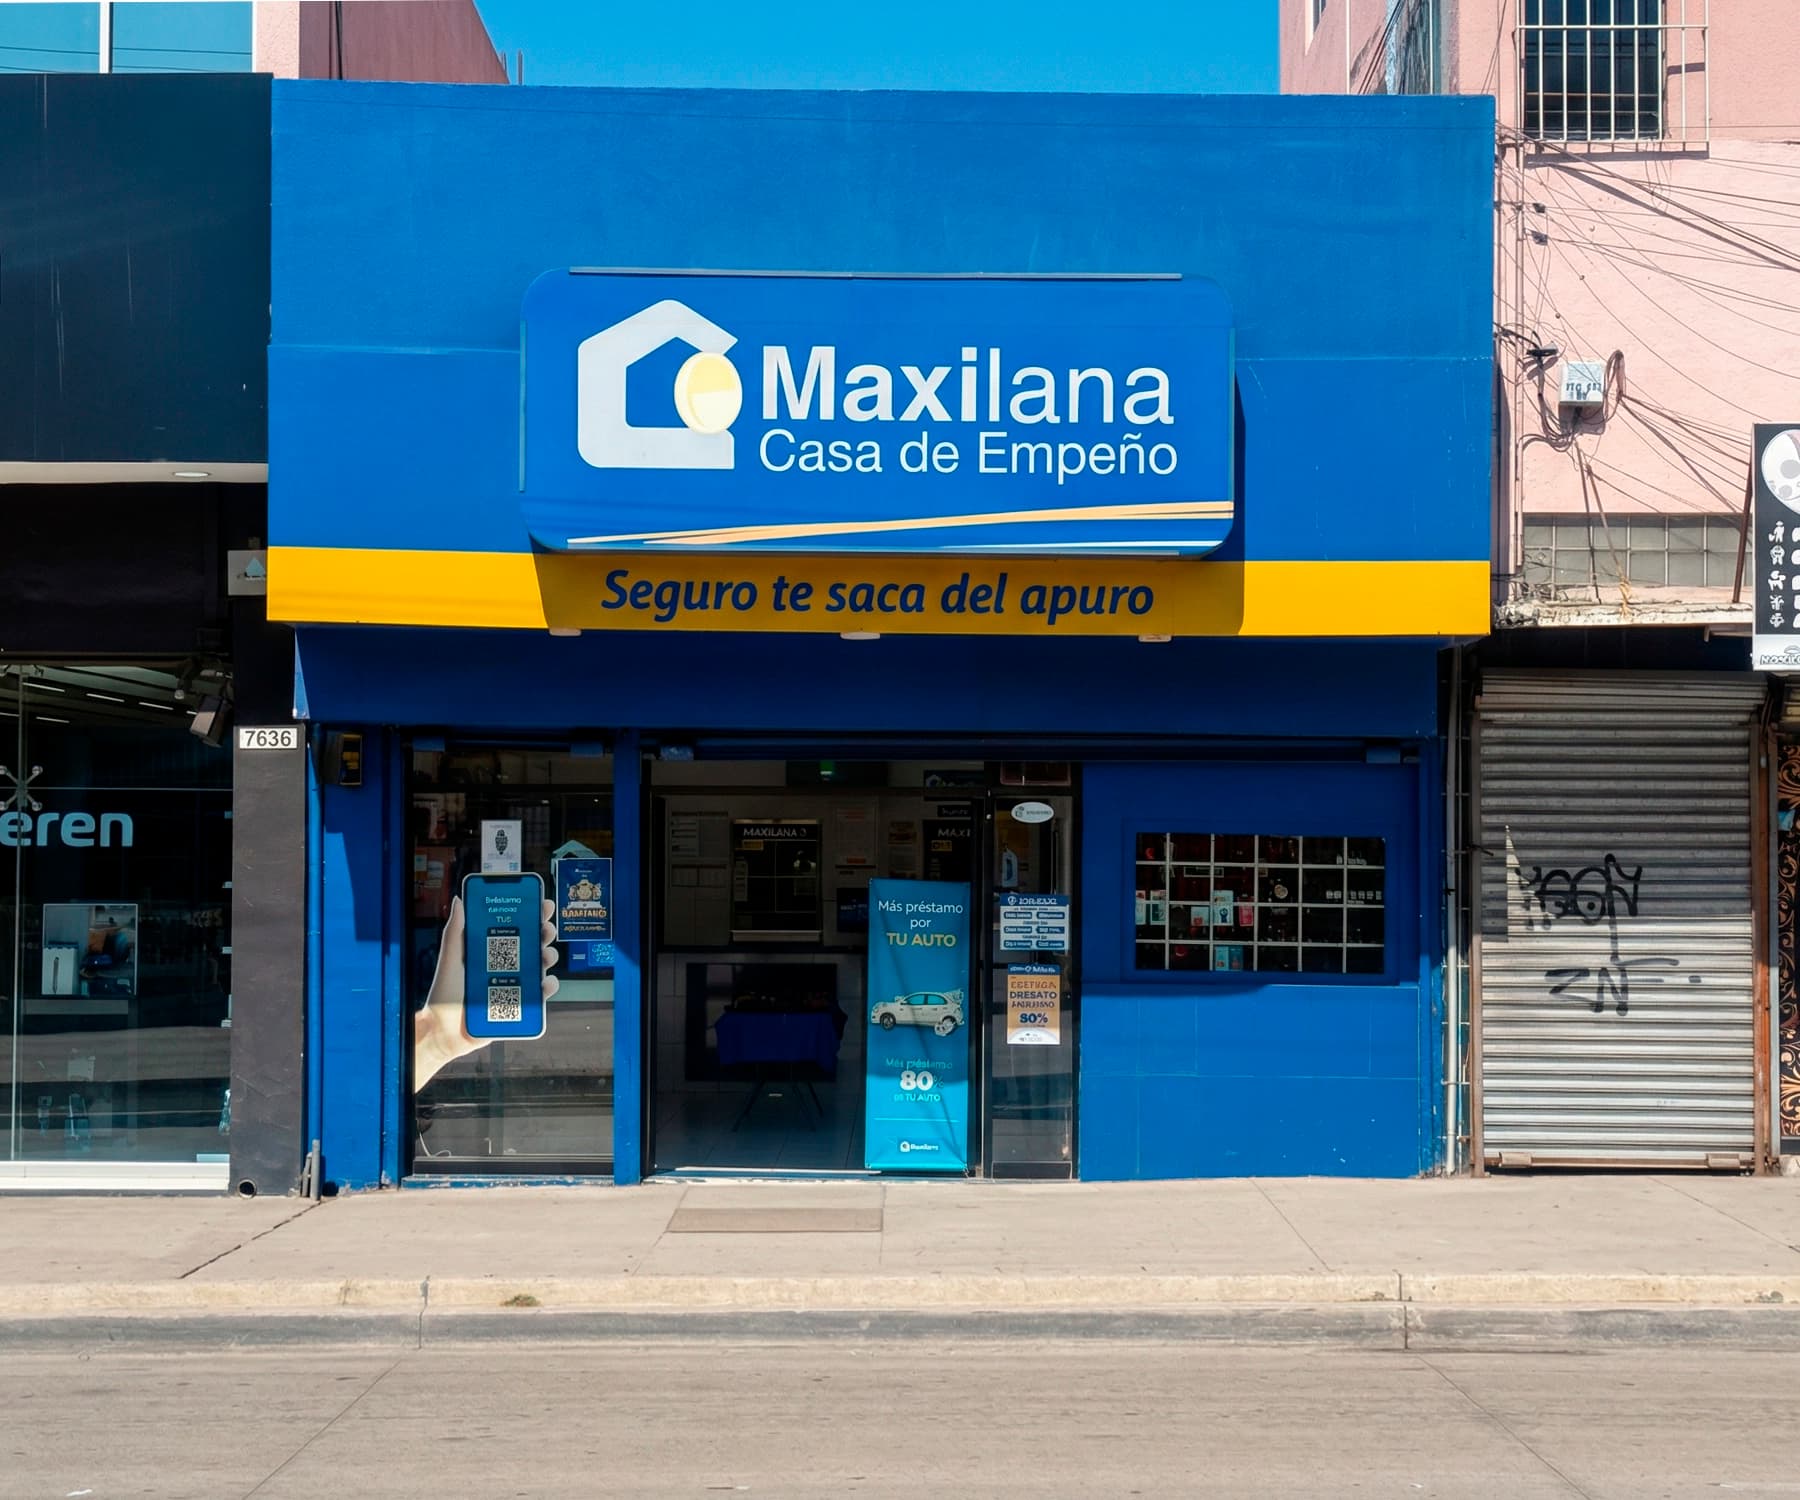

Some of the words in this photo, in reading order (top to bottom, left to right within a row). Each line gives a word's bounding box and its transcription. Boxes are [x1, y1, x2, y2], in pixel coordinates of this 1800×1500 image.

[763, 346, 1174, 424] Maxilana
[760, 429, 883, 473] Casa
[899, 431, 959, 473] de
[979, 431, 1178, 485] Empeño
[601, 569, 758, 623] Seguro
[772, 575, 814, 612] te
[825, 582, 926, 613] saca
[940, 571, 1009, 614] del
[1020, 585, 1154, 626] apuro
[245, 730, 292, 747] 7636
[0, 811, 134, 847] eren
[743, 827, 798, 838] MAXILANA
[878, 900, 903, 912] Más
[905, 901, 964, 915] préstamo
[910, 919, 932, 929] por
[886, 932, 908, 946] TU
[911, 933, 957, 947] AUTO
